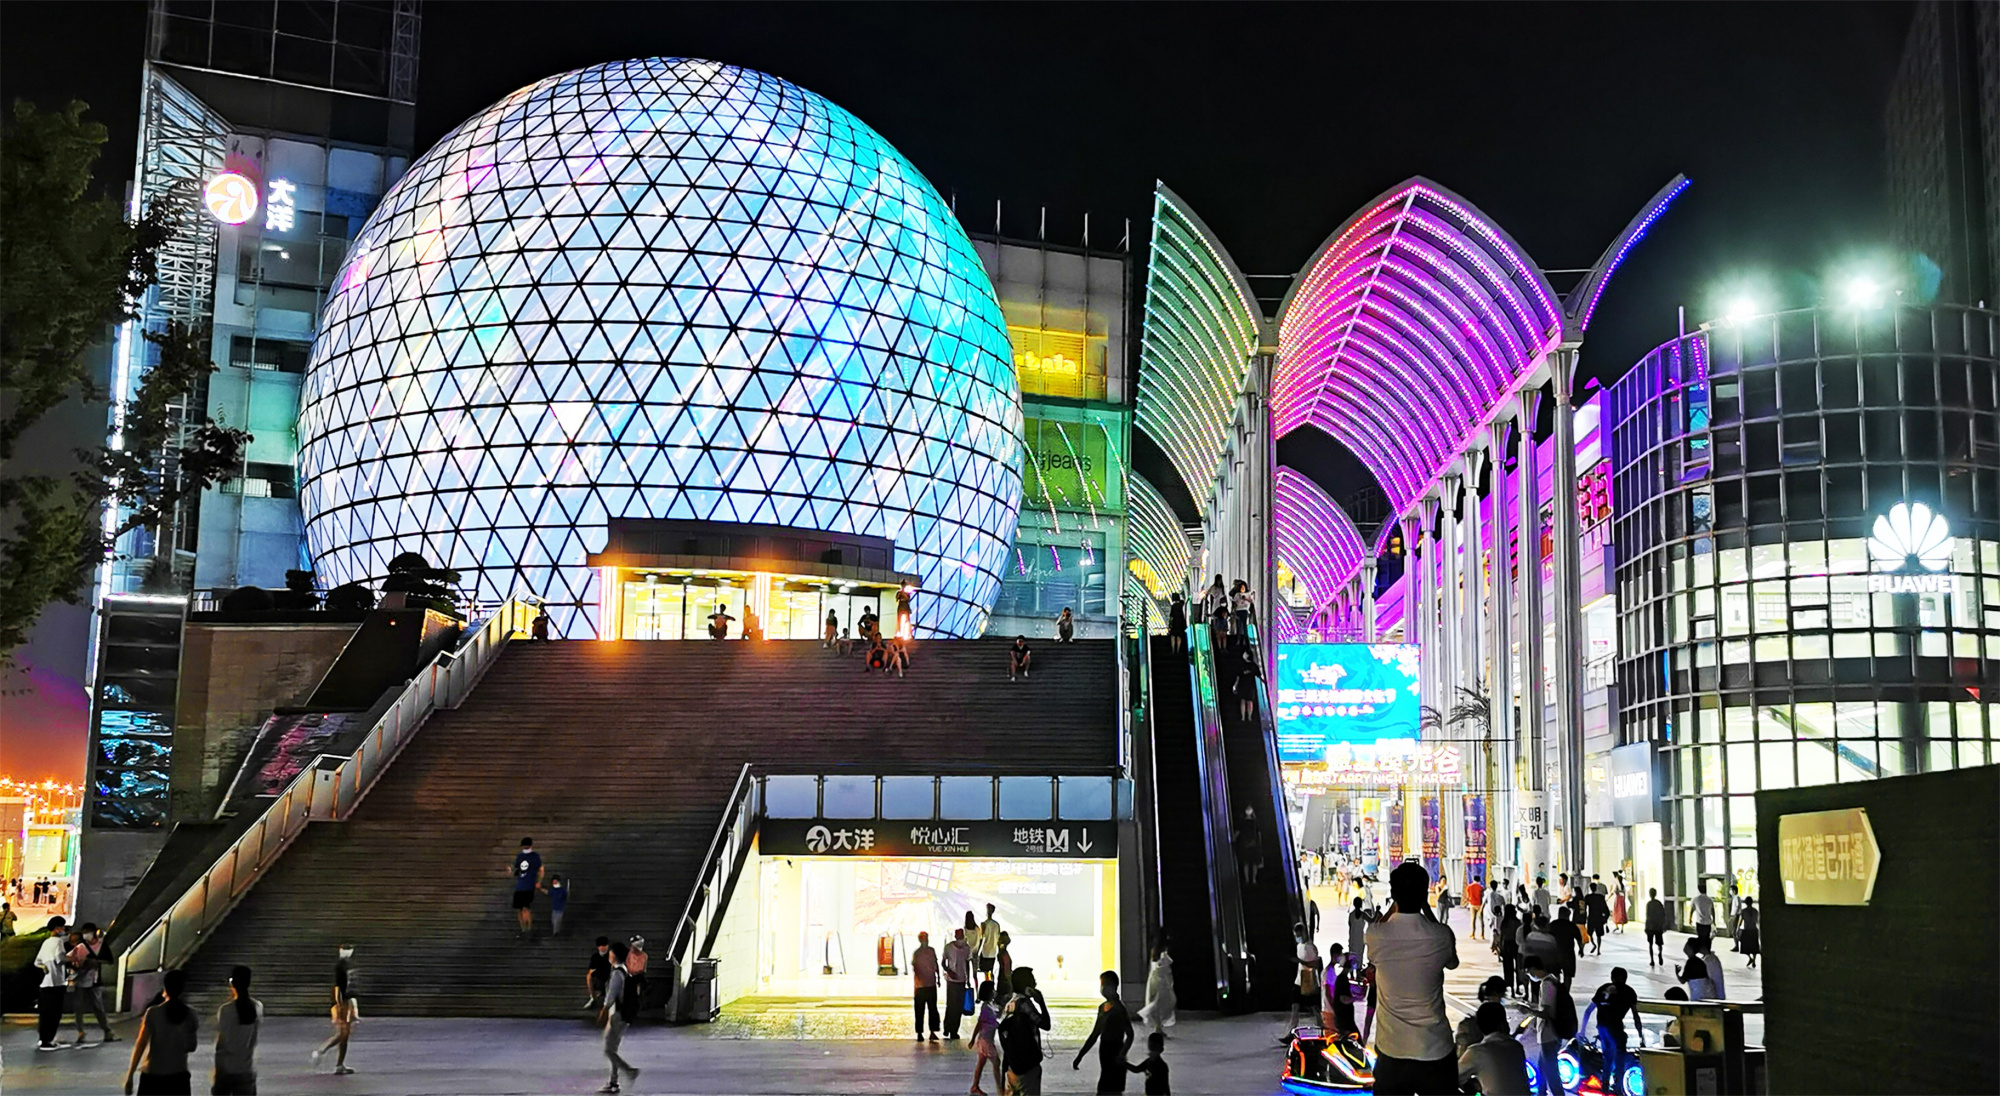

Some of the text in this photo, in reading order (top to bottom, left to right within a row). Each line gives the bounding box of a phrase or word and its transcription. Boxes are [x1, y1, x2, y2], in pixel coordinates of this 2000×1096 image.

[266, 179, 296, 232] 大洋
[1869, 575, 1957, 593] HUAWEI
[1373, 773, 1409, 784] NIGHT
[1413, 773, 1462, 784] MARKET
[1613, 771, 1648, 799] HUAWEI
[1518, 807, 1541, 822] 文明
[833, 828, 875, 850] 大洋
[910, 827, 970, 845] 悦心汇
[1013, 827, 1045, 844] 地铁
